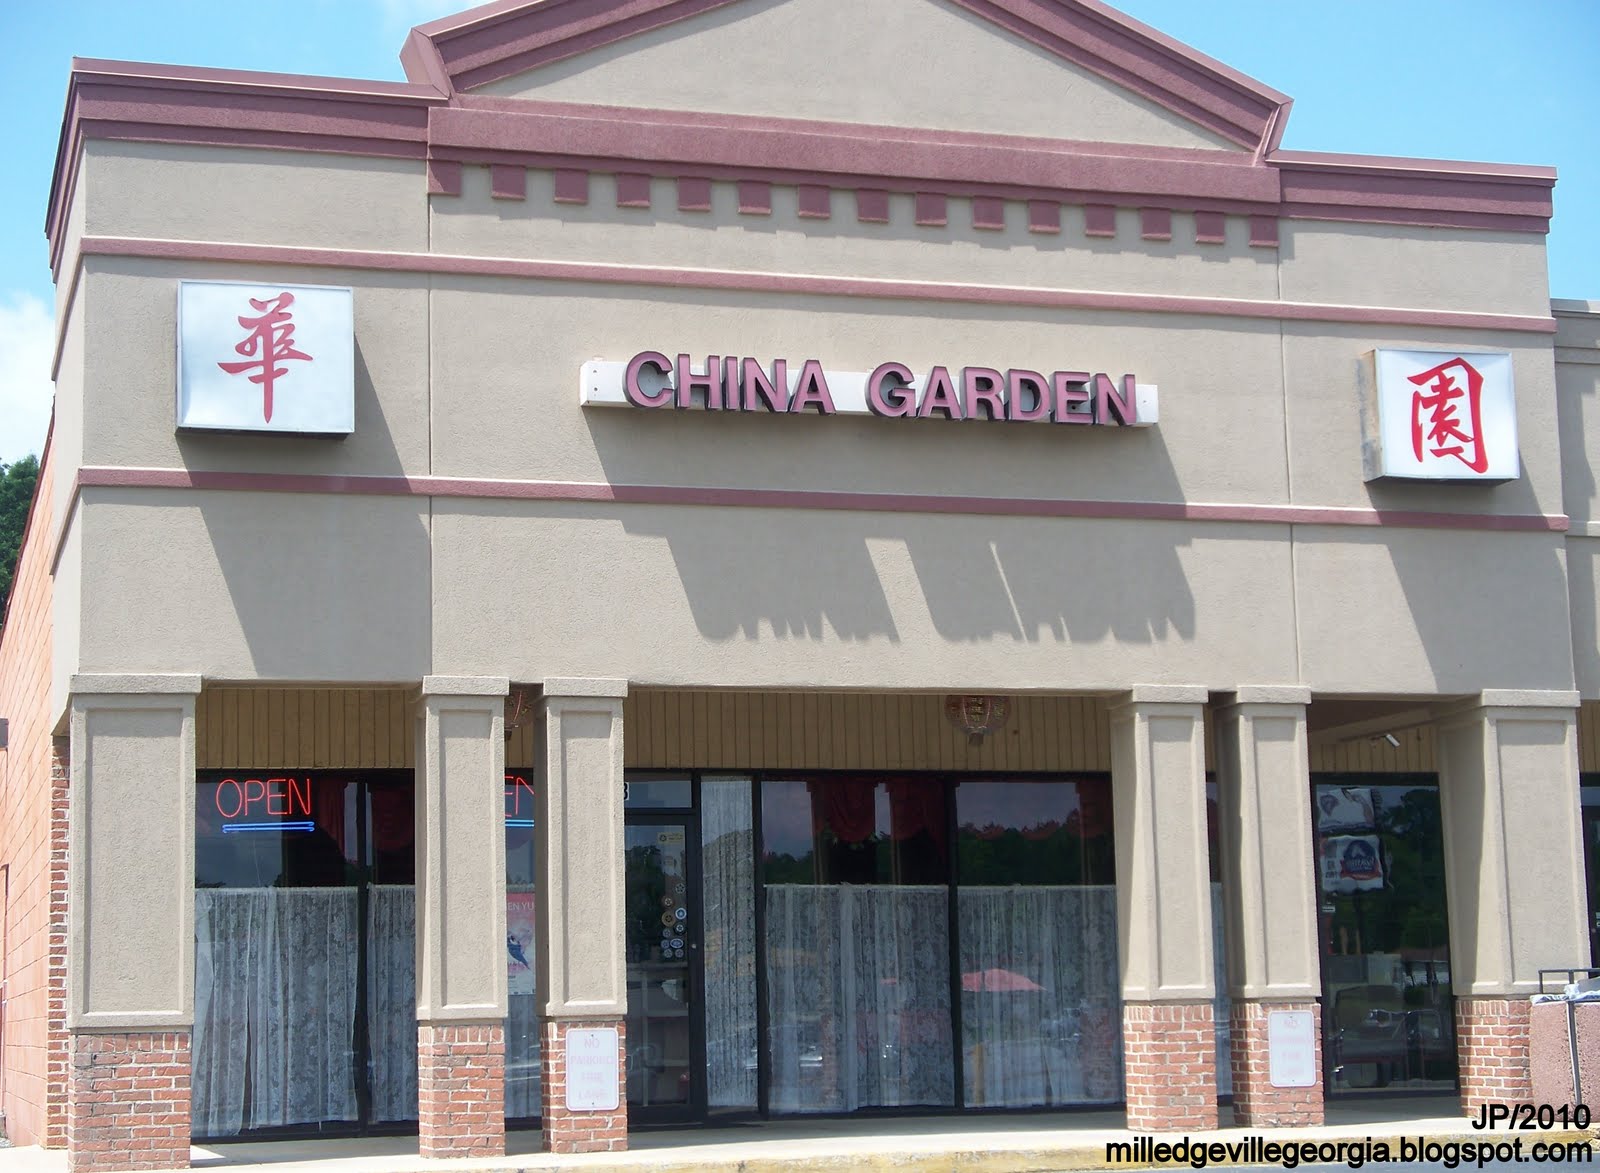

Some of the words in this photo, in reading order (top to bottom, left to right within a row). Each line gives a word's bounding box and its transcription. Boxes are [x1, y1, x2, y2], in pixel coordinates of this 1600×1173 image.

[217, 291, 313, 424] 華
[622, 350, 836, 415] CHINA
[865, 361, 1138, 427] GARDEN
[1407, 356, 1489, 474] 園
[215, 778, 312, 818] OPEN
[504, 776, 535, 818] EN
[584, 1038, 600, 1049] NO
